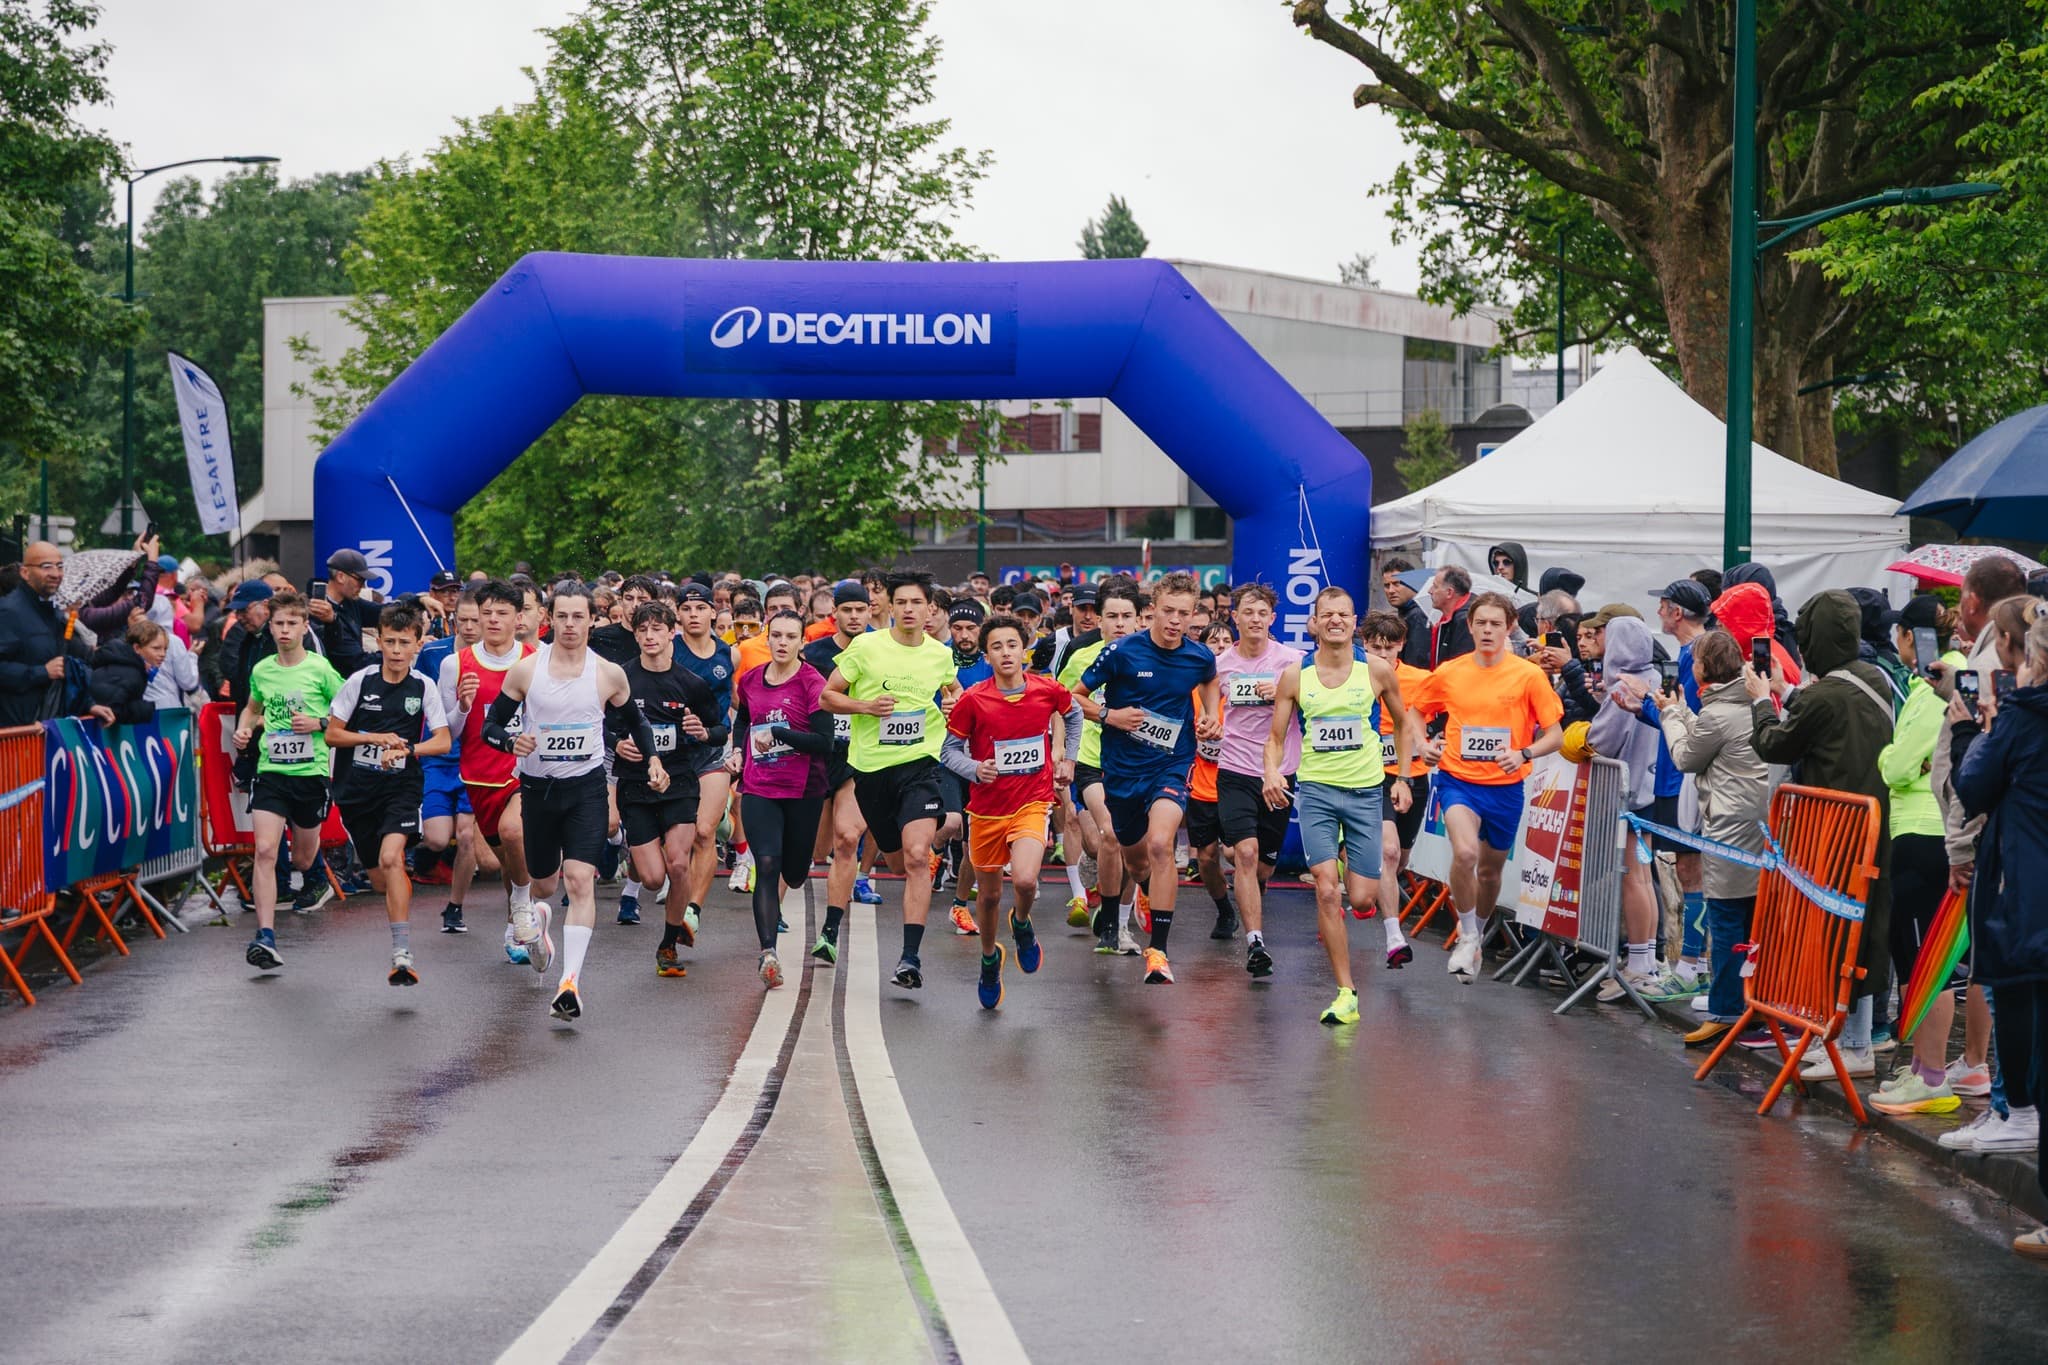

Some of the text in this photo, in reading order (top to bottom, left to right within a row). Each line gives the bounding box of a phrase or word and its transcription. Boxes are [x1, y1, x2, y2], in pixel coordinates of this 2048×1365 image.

[768, 312, 991, 345] DECATHLON
[197, 405, 227, 523] ESAFFRE
[887, 722, 920, 735] 2093
[1139, 721, 1172, 741] 2408
[1320, 728, 1353, 741] 2401
[273, 741, 305, 755] 2137
[547, 736, 585, 750] 2267
[1003, 749, 1039, 765] 2229
